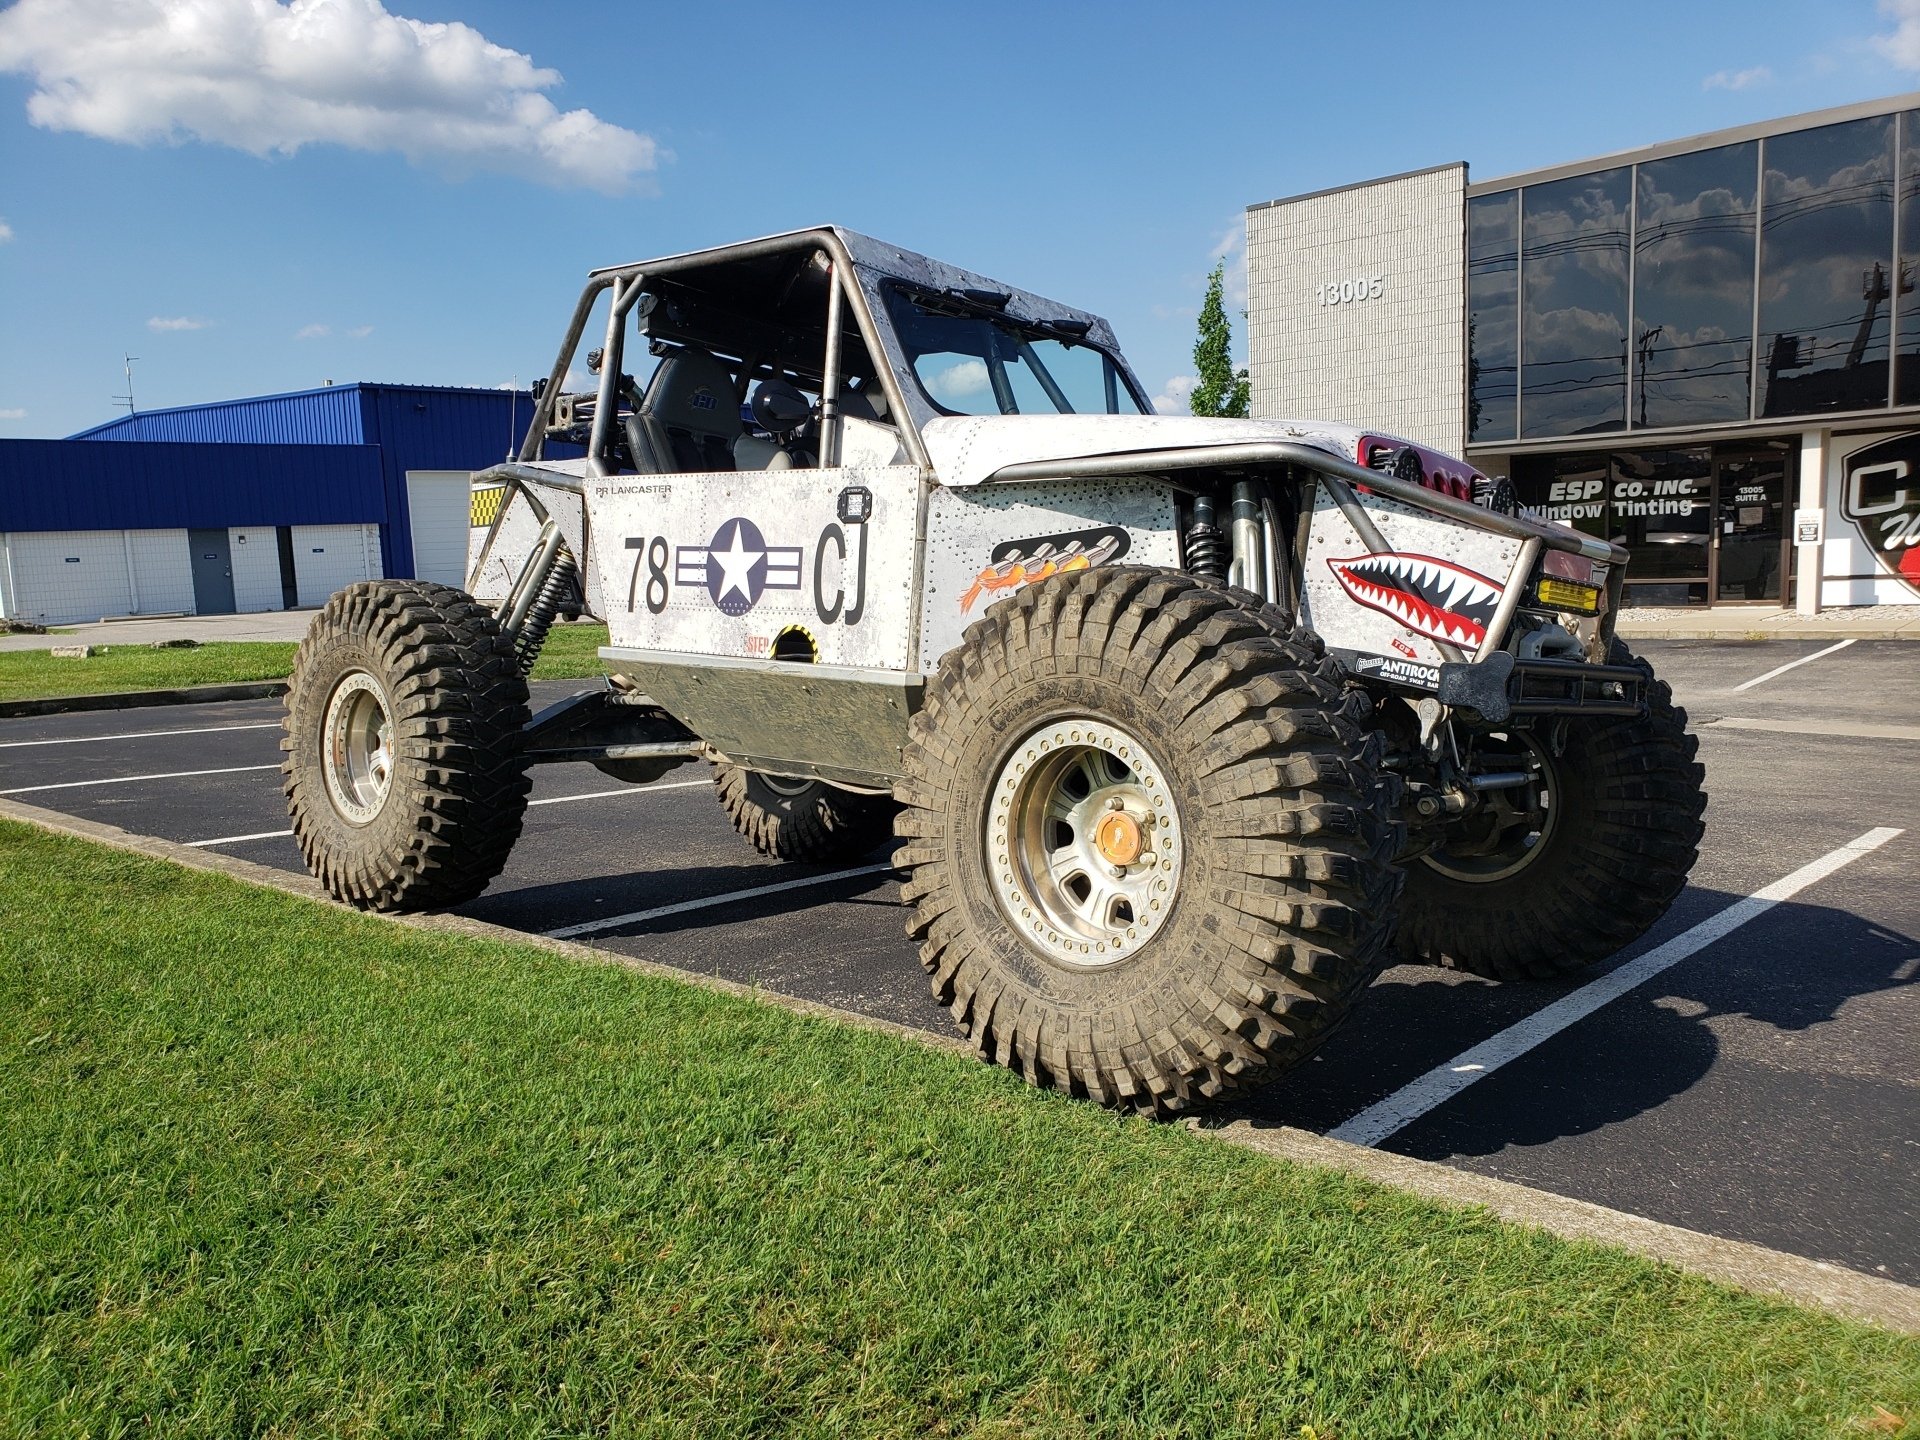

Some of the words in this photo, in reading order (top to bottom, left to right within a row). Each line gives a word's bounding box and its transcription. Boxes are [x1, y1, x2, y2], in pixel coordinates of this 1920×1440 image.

[1316, 276, 1384, 306] 13005
[596, 487, 608, 495] PR
[611, 485, 672, 495] LANCASTER
[1549, 480, 1603, 501] ESP
[1614, 482, 1648, 498] CO.
[1653, 478, 1699, 496] INC.
[1739, 486, 1764, 494] 13005
[1523, 504, 1603, 519] Window
[1615, 498, 1692, 517] Tinting
[625, 535, 669, 615] 78
[814, 522, 868, 625] CJ
[746, 634, 769, 653] STEP
[1394, 640, 1411, 652] TOW
[1380, 671, 1407, 681] OFF-ROAD
[1409, 677, 1425, 686] SWAY
[1427, 681, 1439, 689] BAR
